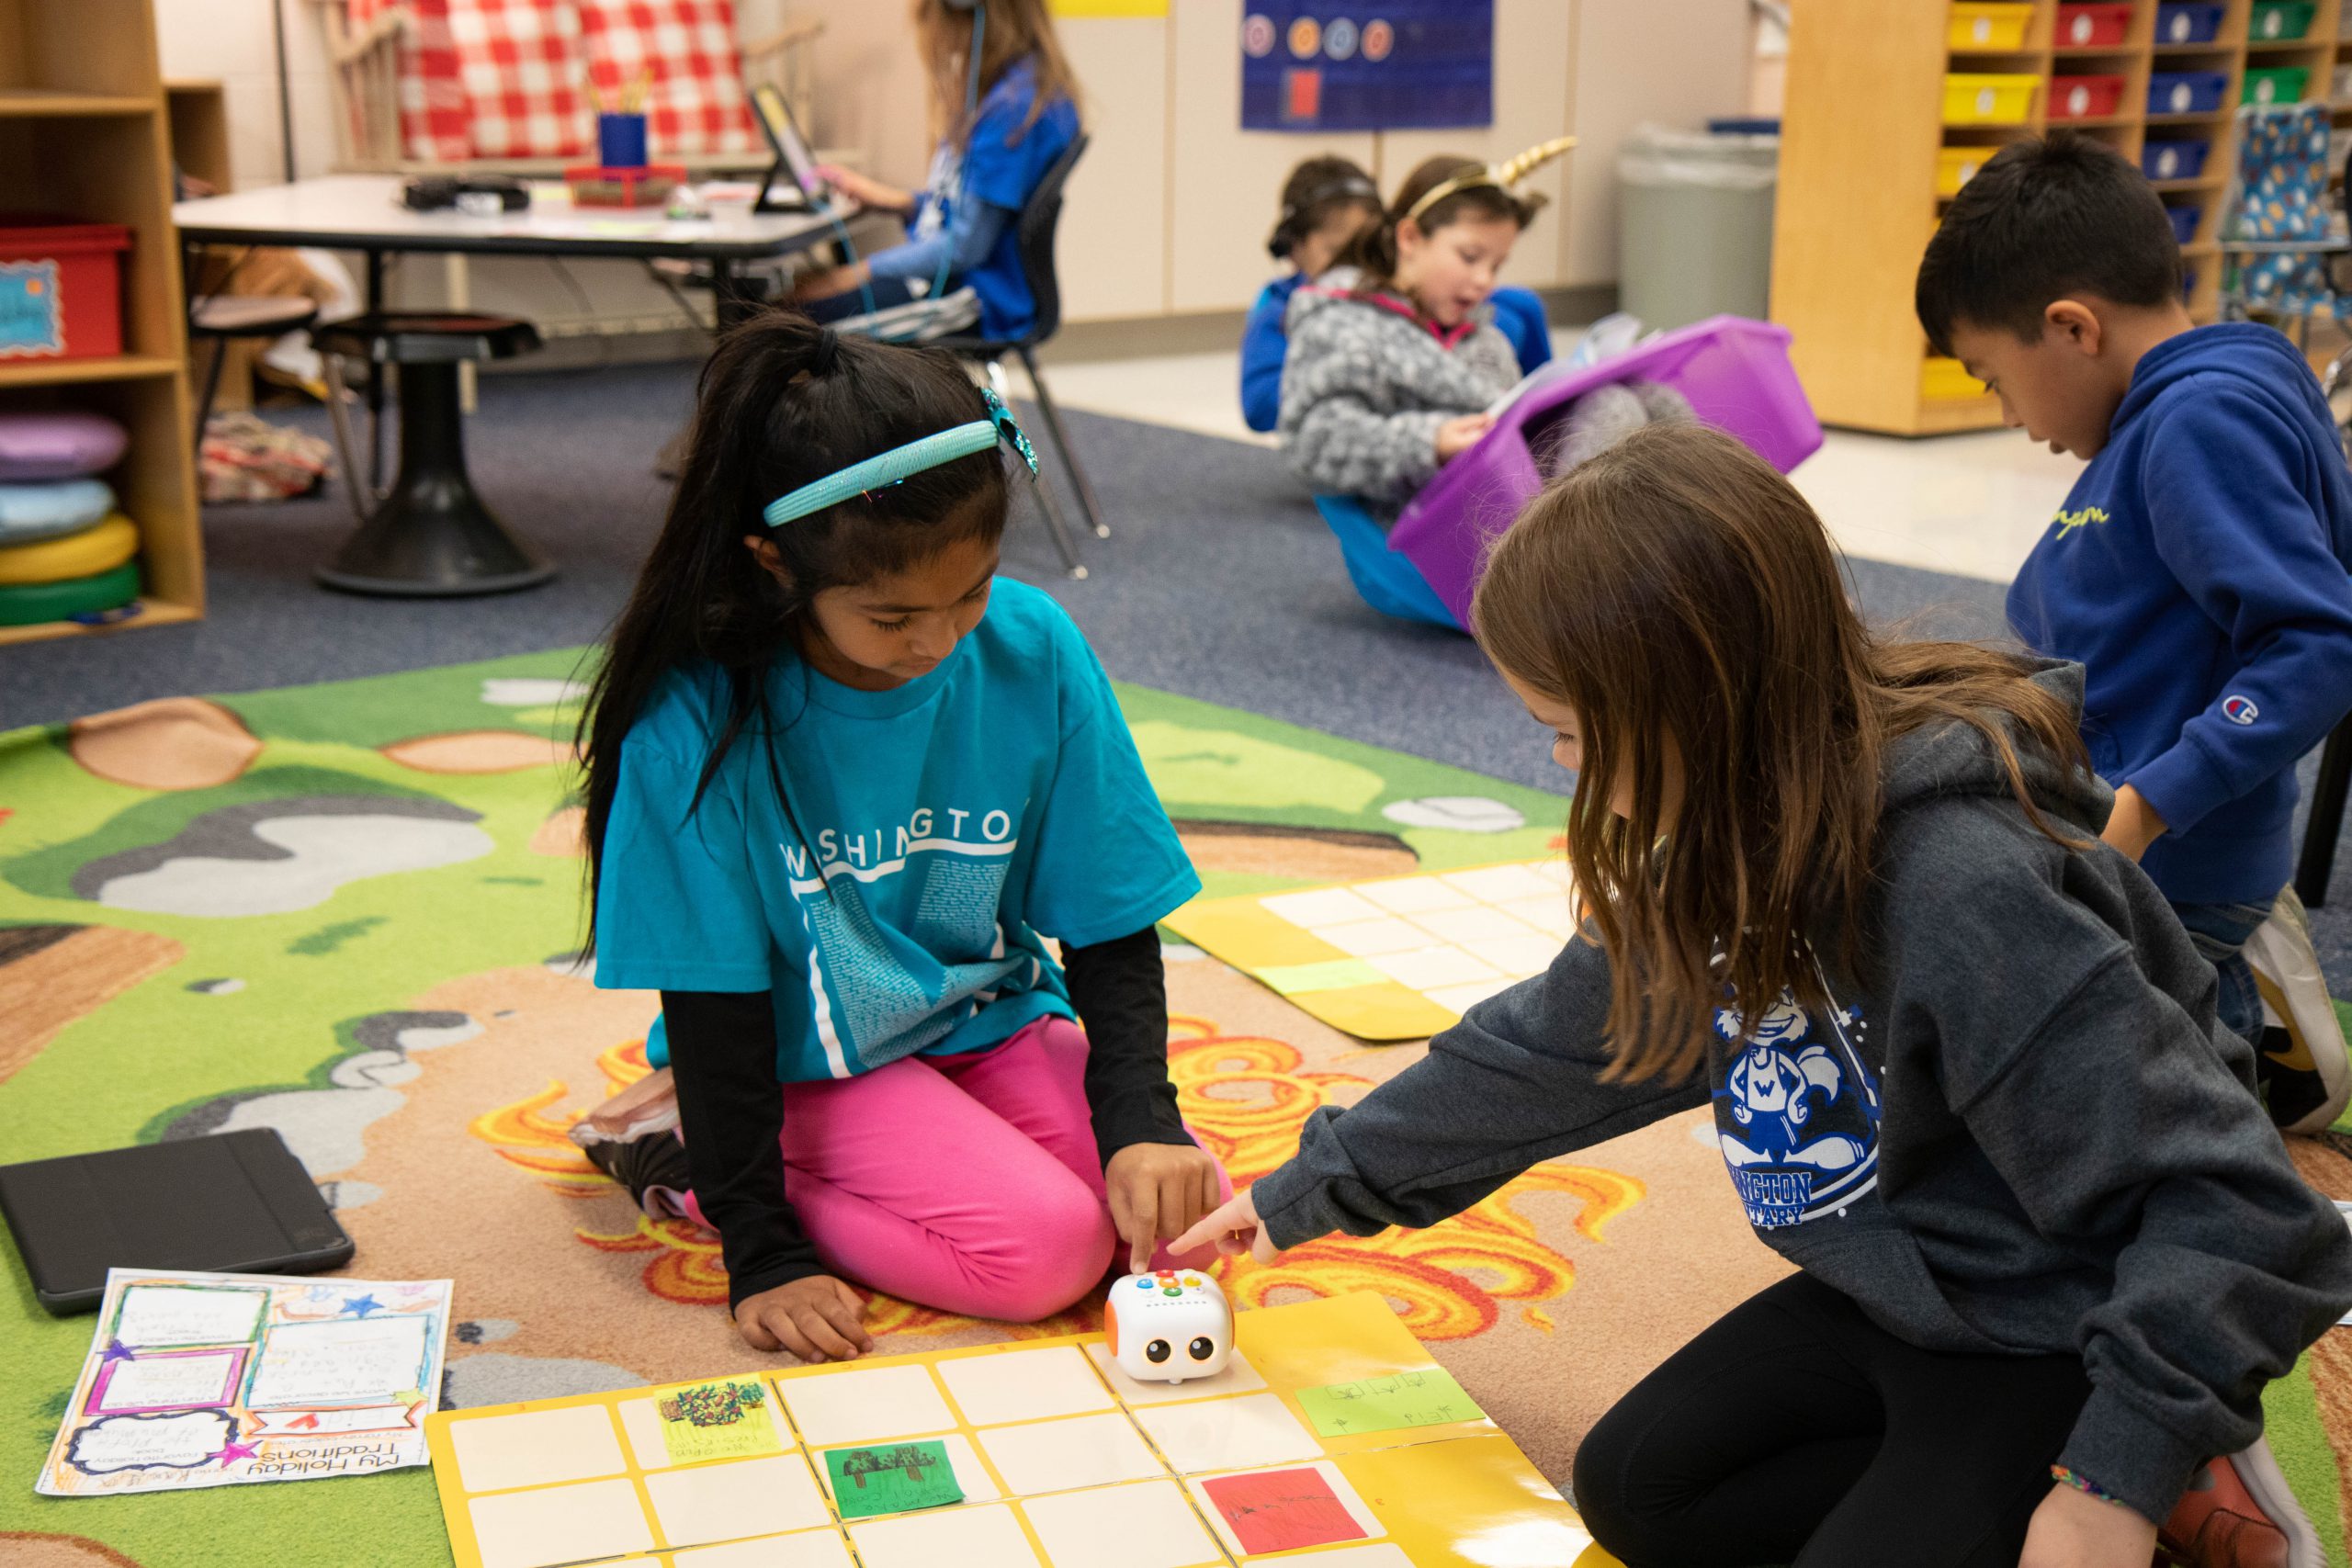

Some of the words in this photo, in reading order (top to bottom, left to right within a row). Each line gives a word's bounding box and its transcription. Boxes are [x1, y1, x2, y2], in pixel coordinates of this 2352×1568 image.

[779, 807, 1012, 878] WSHINGTO
[1753, 1079, 1776, 1099] W
[261, 1442, 396, 1463] Traditions
[358, 1452, 400, 1469] My
[246, 1457, 348, 1476] Holiday
